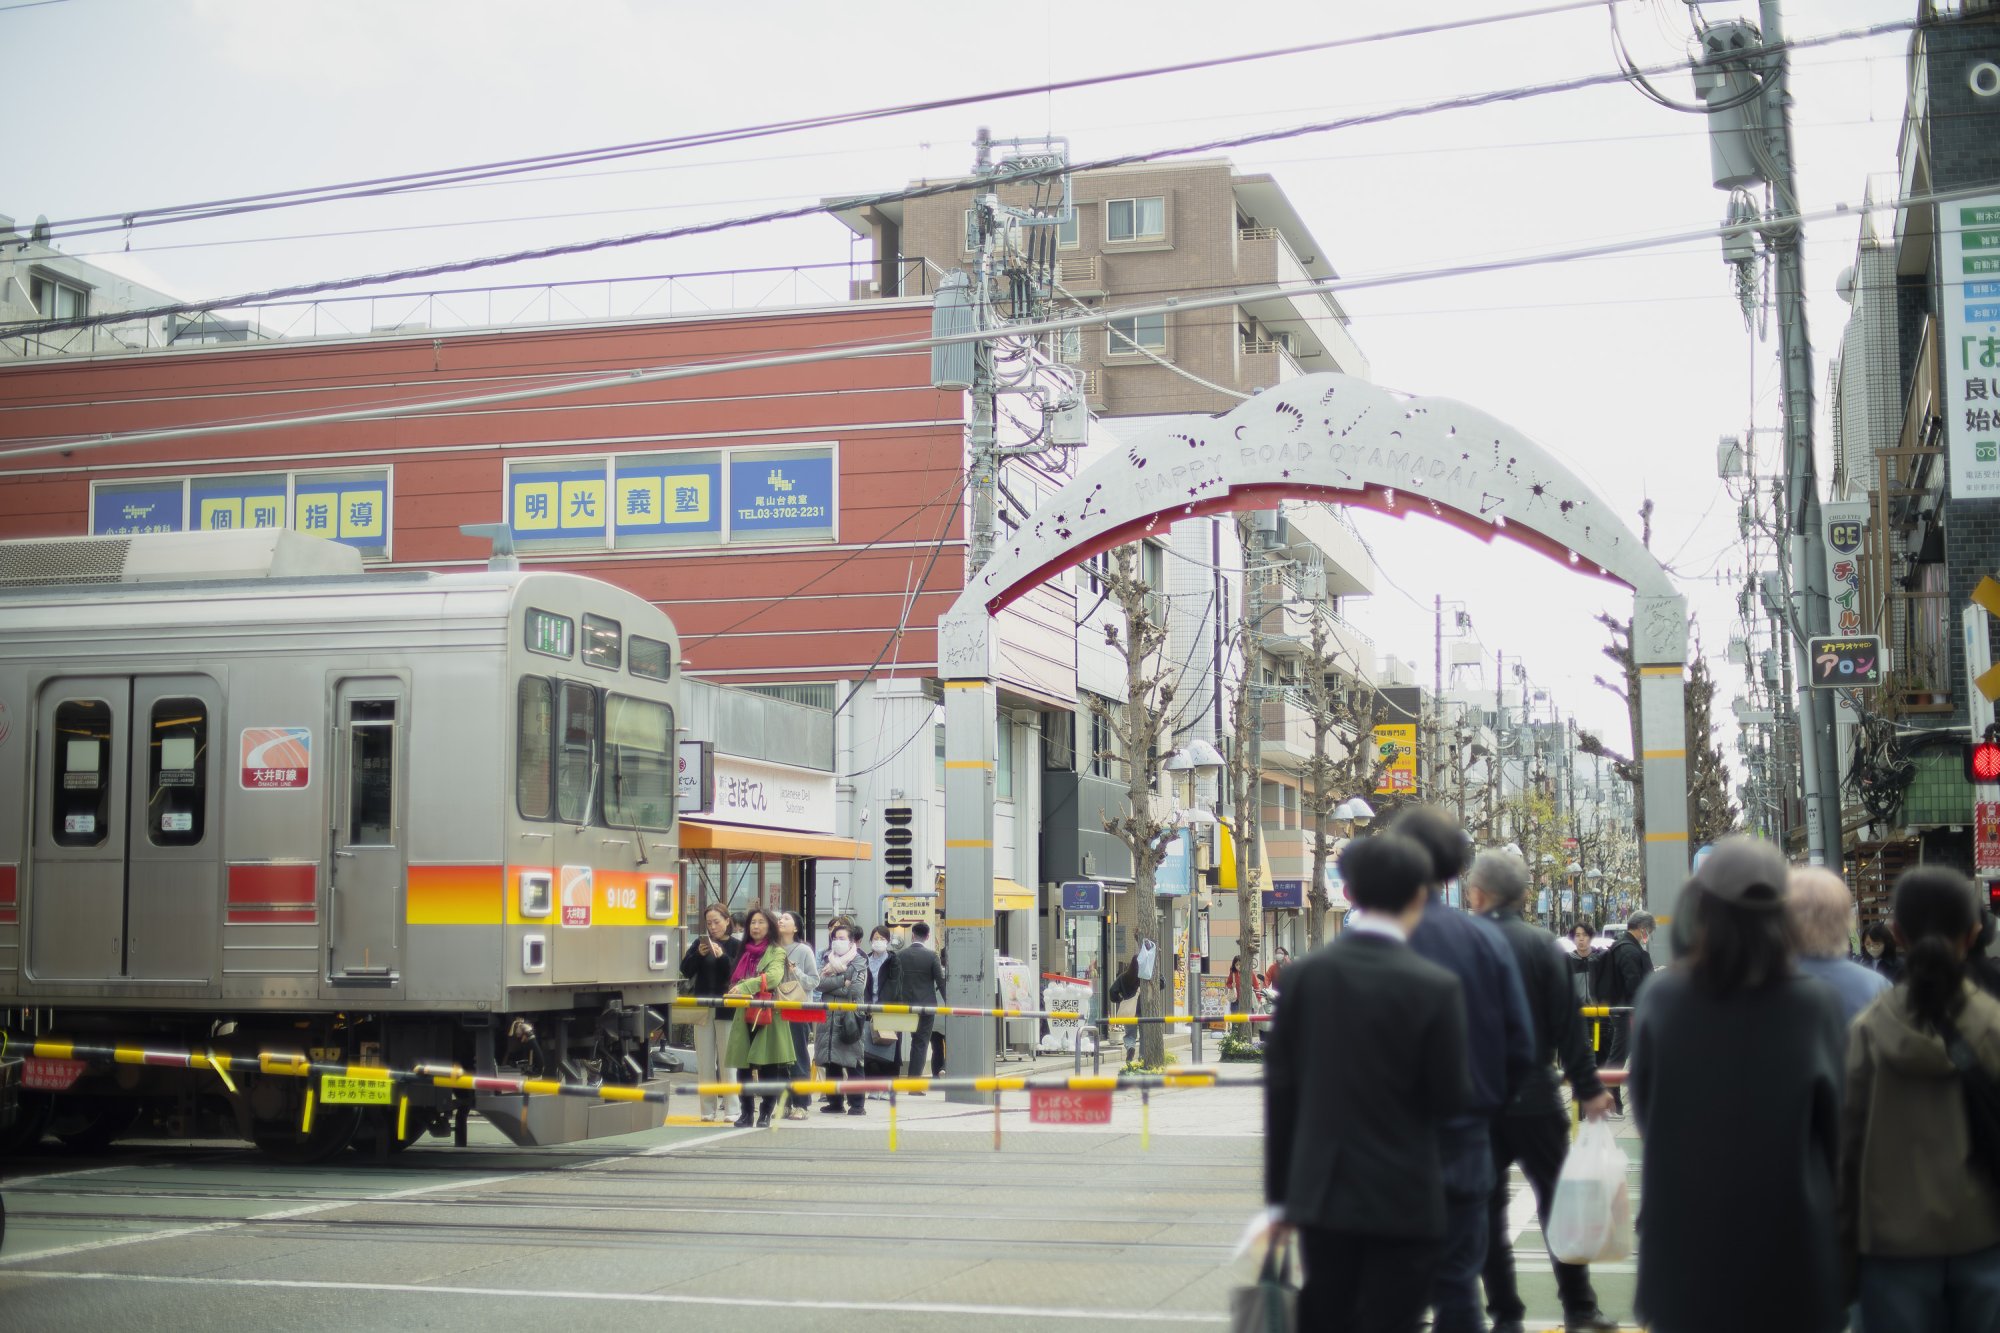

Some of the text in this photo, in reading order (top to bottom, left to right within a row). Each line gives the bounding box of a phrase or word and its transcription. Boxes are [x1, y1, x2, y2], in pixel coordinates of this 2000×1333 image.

[1135, 443, 1478, 500] HAPPY ROAD OYAMADAI
[525, 487, 700, 519] 明光義塾
[755, 494, 808, 507] 尾山台教室
[211, 502, 373, 529] 個別指導
[1833, 526, 1858, 546] CE
[1822, 643, 1872, 652] カラオケサロン
[1816, 654, 1876, 678] アロン
[253, 769, 297, 781] 大井町線
[728, 777, 767, 812] さぼてん
[885, 807, 913, 927] DOUT
[607, 888, 637, 908] 9102
[327, 1080, 386, 1088] 無理な横断は
[327, 1091, 387, 1099] おやめ下さい
